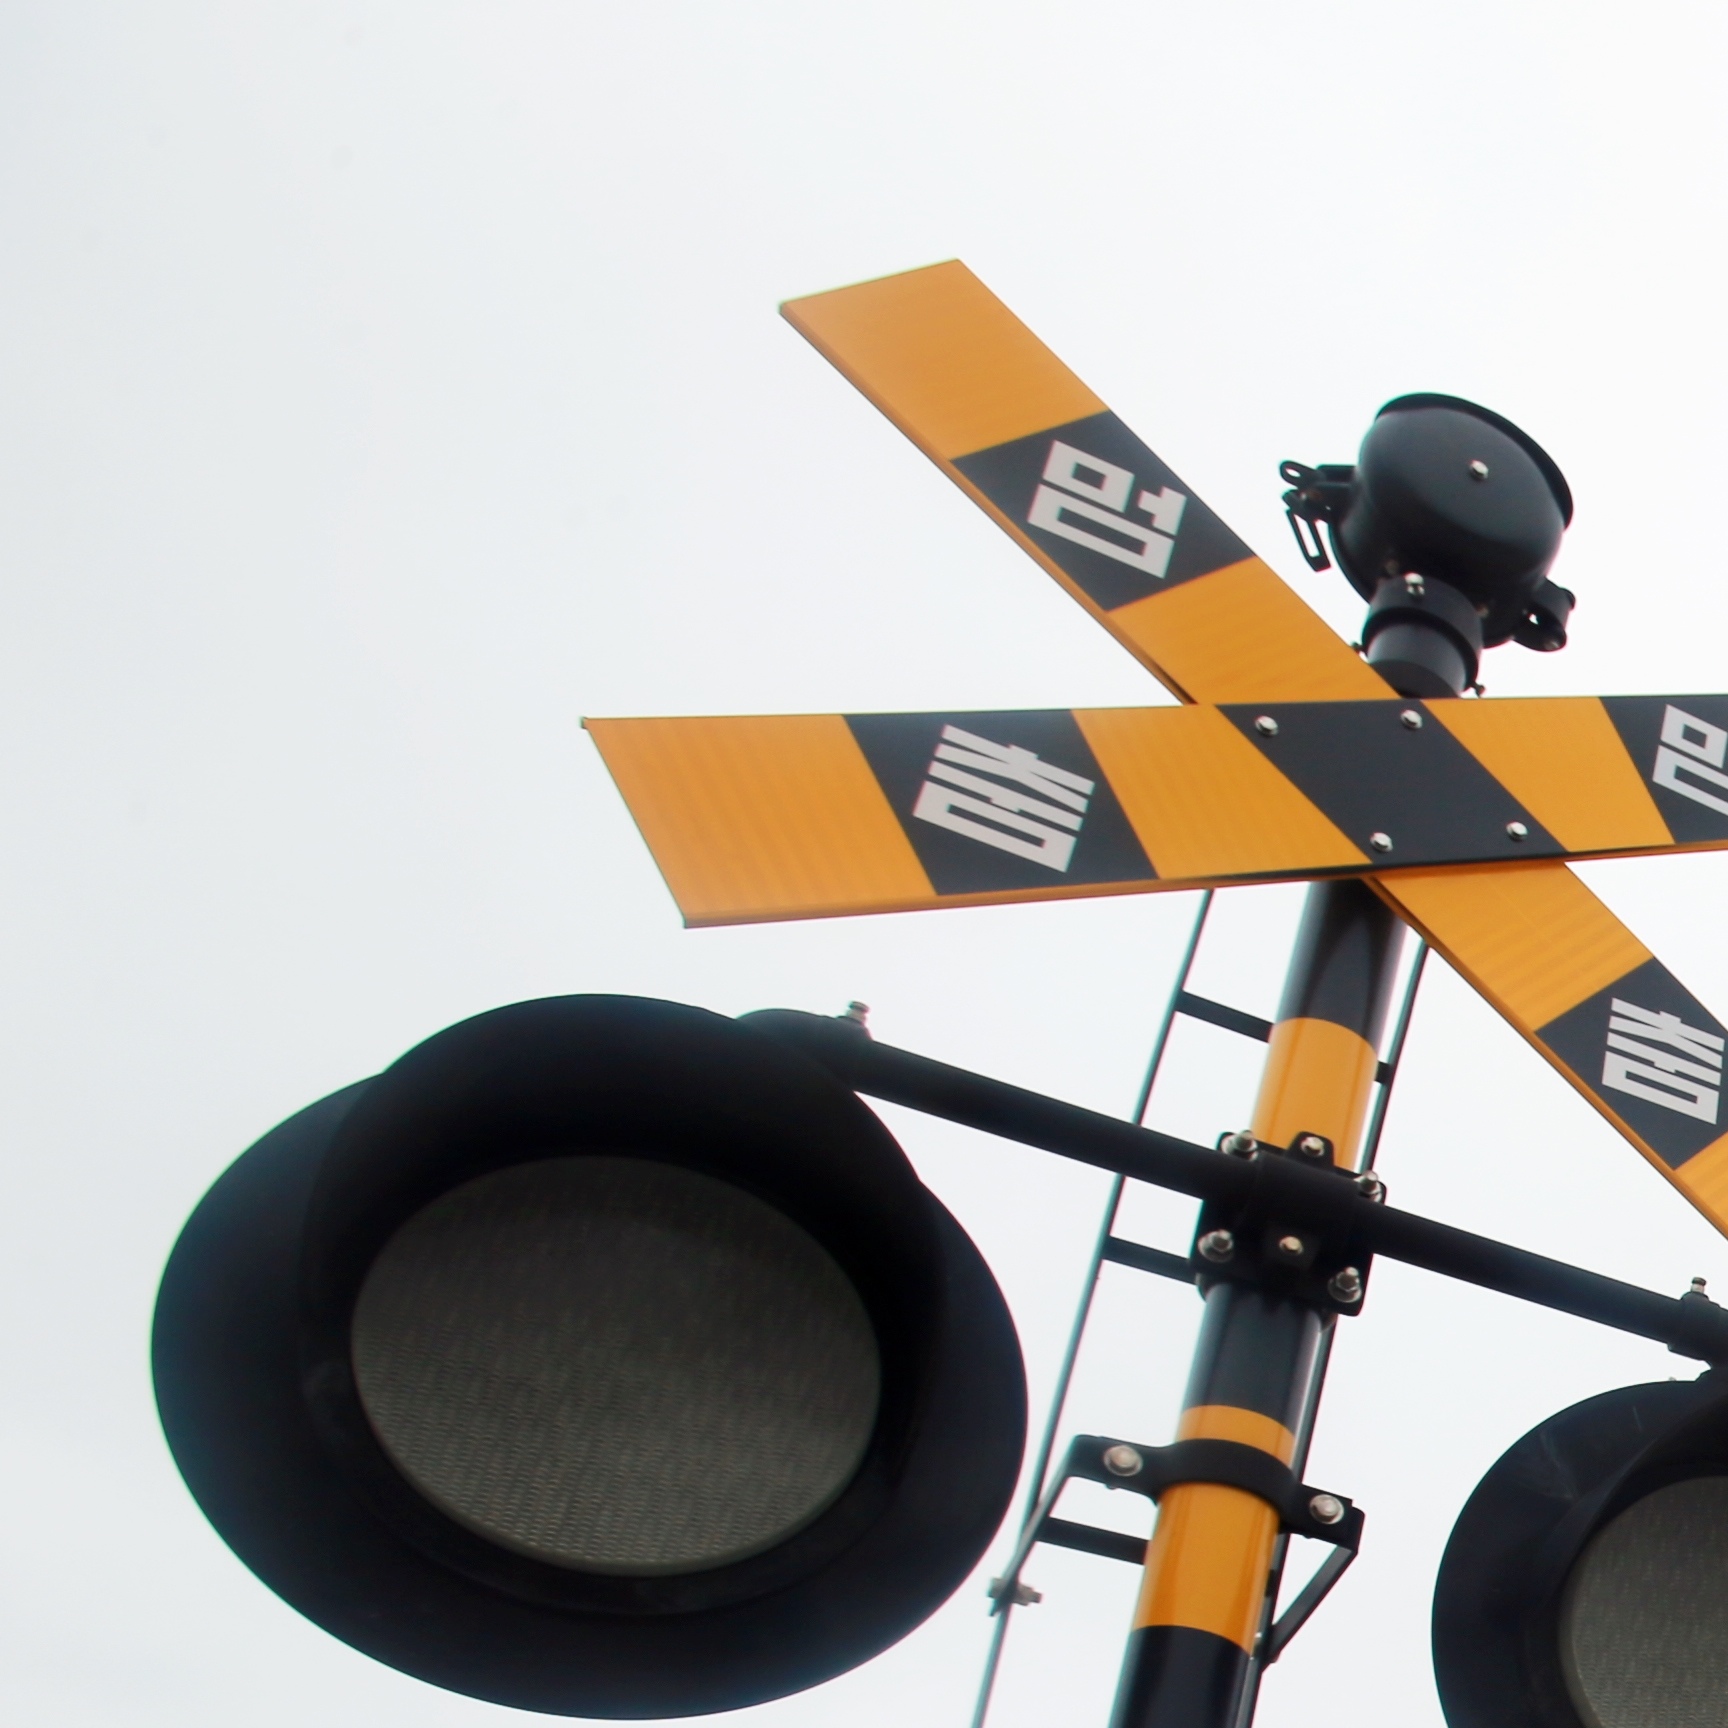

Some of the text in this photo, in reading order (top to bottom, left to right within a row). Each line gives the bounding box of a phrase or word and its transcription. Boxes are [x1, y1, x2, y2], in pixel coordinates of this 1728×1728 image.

[912, 723, 1095, 873] 춤
[1027, 439, 1725, 1125] 멈 춤
